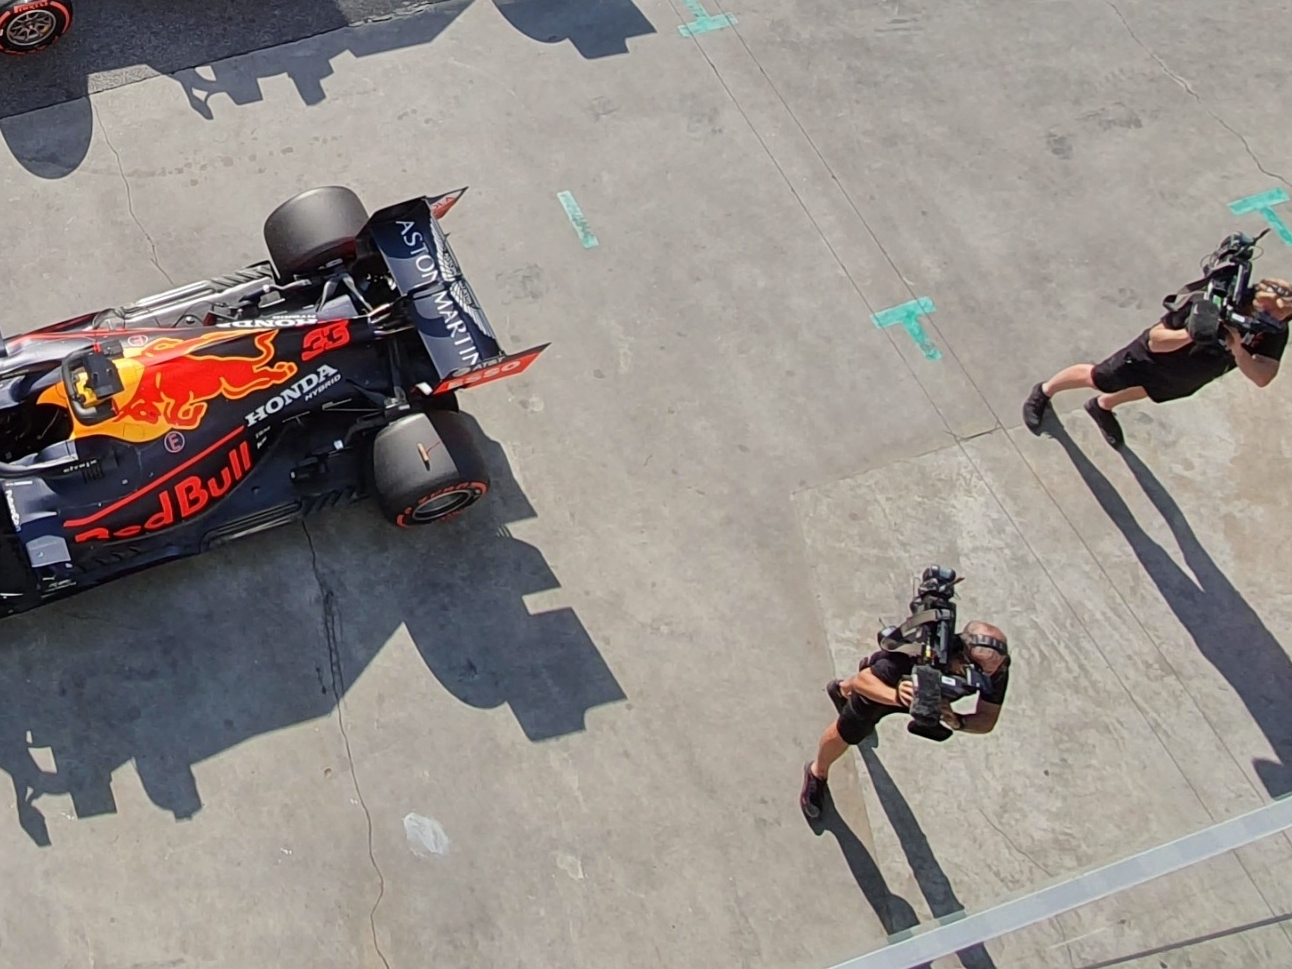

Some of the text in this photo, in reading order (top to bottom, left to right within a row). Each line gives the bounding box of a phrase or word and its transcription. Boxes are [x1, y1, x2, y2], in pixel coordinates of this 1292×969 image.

[395, 220, 440, 289] ASTON
[300, 319, 351, 362] 33
[432, 290, 480, 366] MARTIN
[245, 364, 339, 427] HONDA
[305, 373, 342, 402] HYBRID
[447, 360, 521, 391] ESSO
[174, 440, 253, 519] Bull
